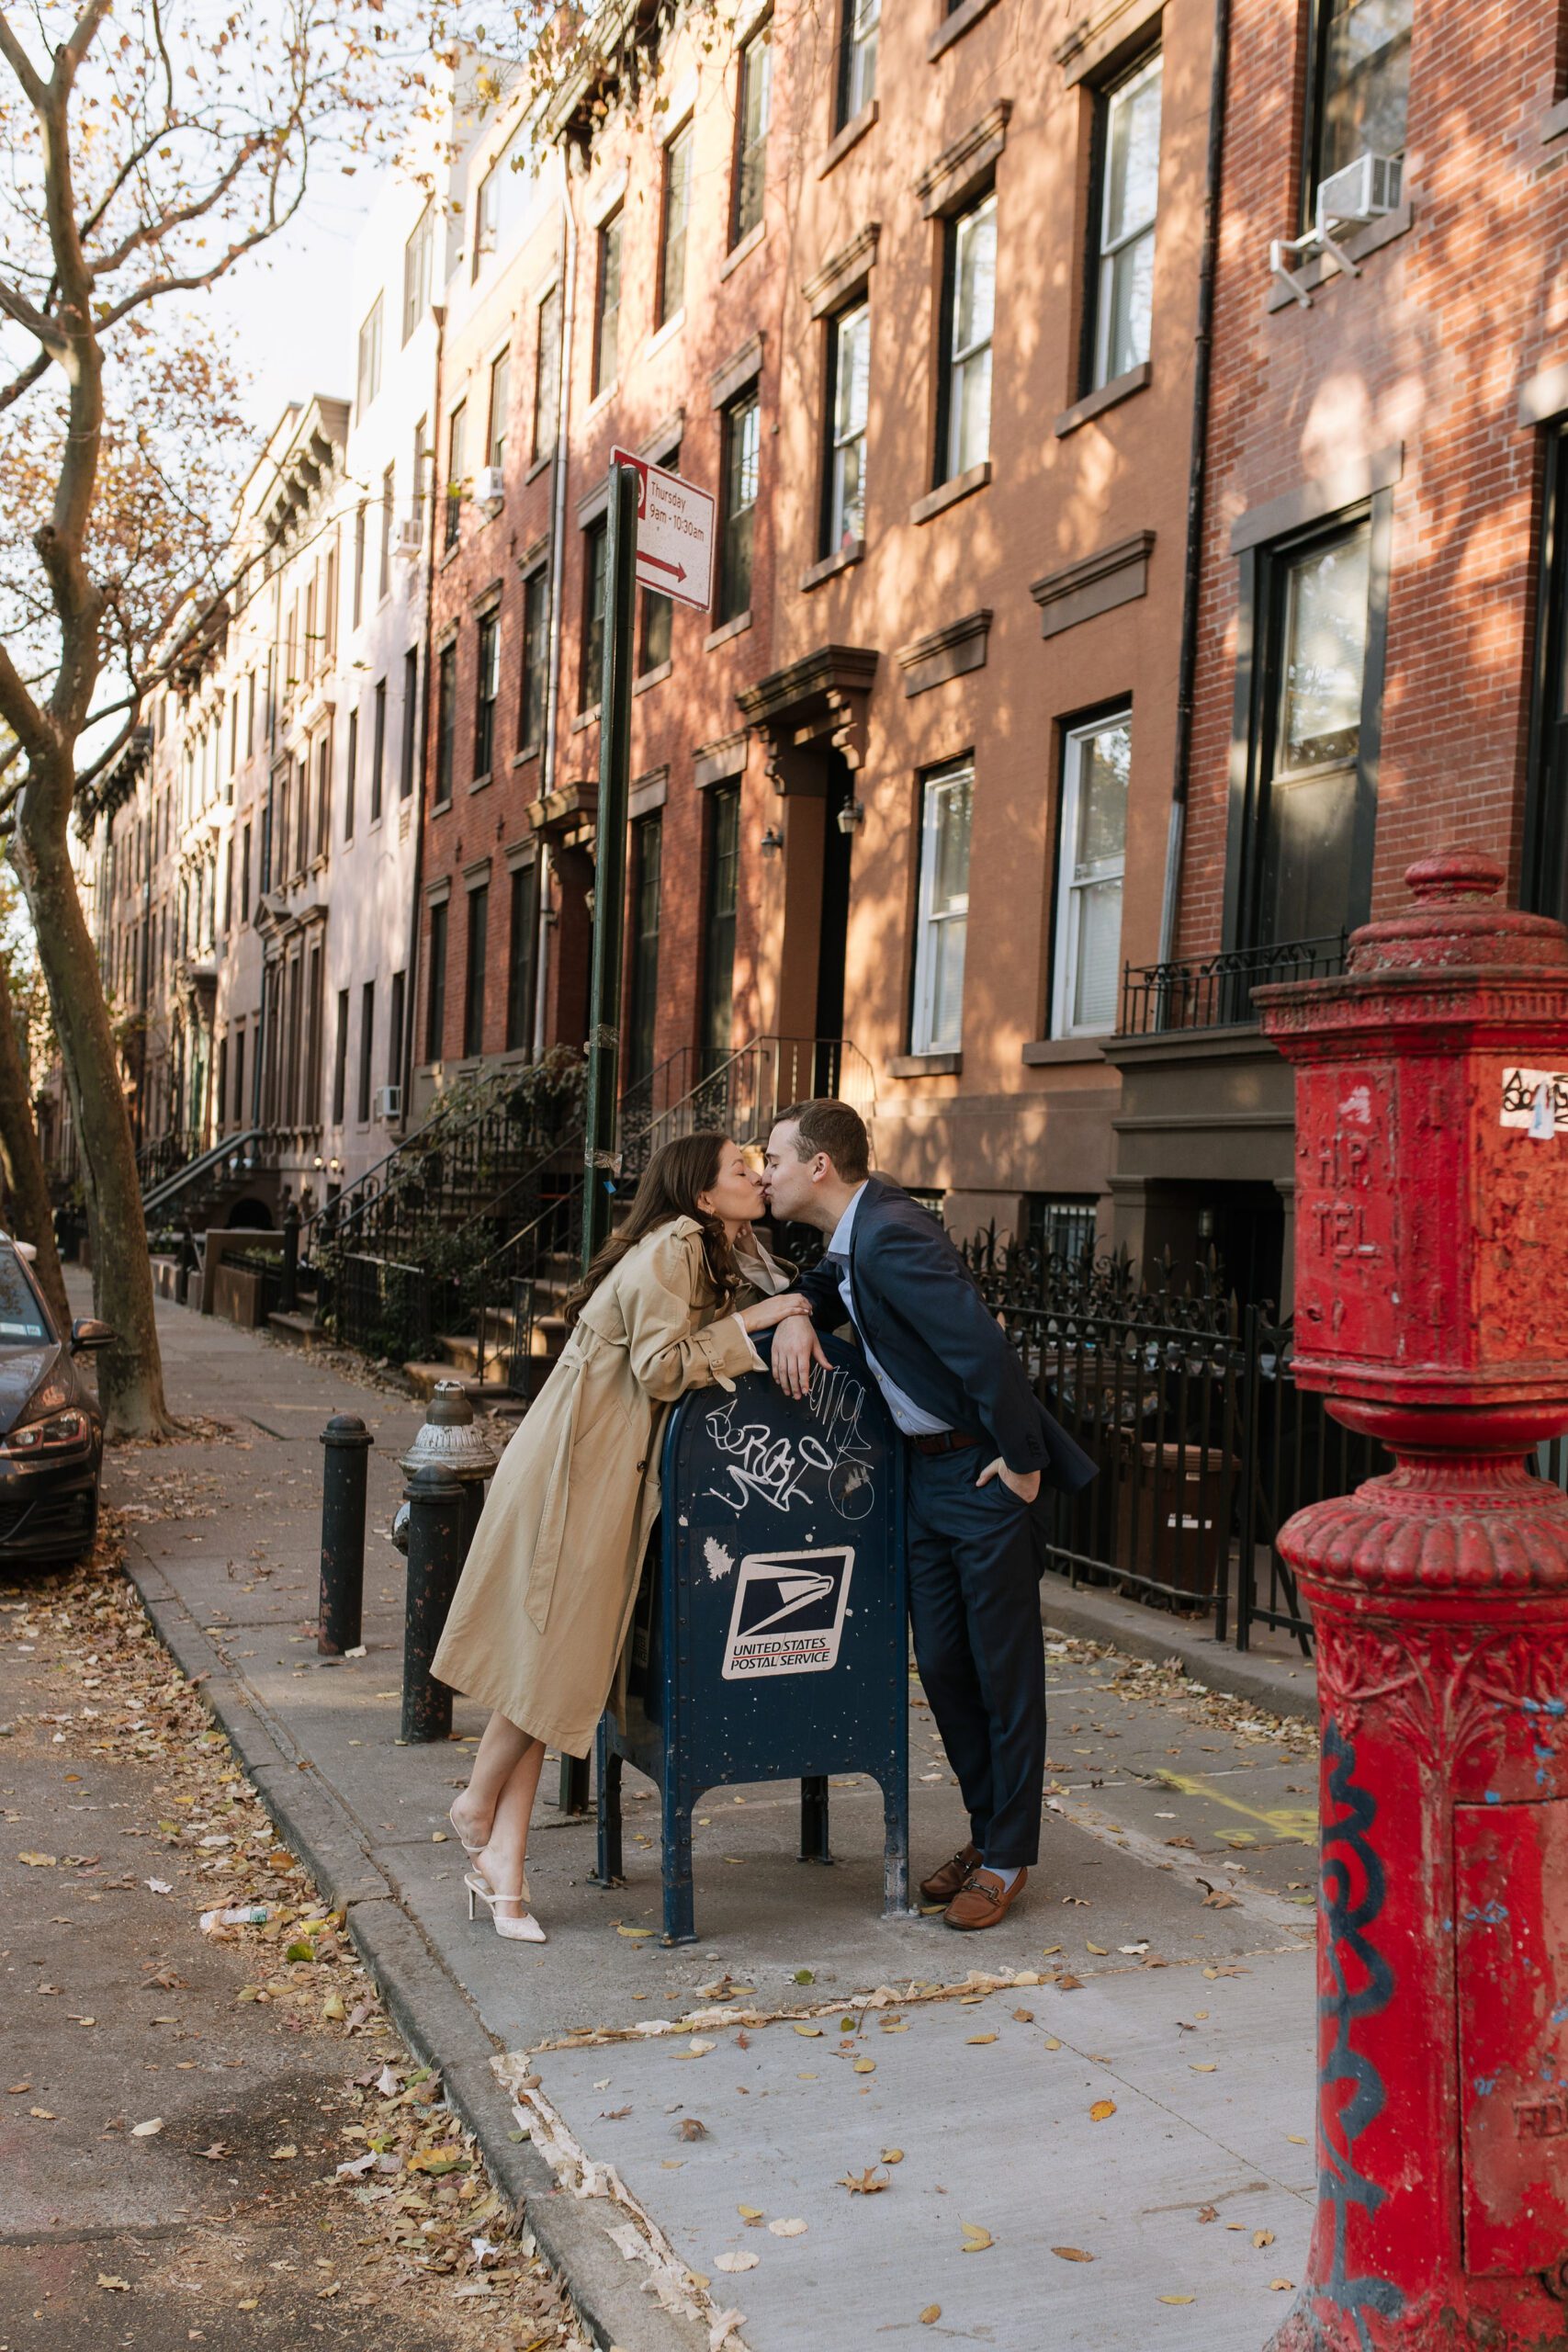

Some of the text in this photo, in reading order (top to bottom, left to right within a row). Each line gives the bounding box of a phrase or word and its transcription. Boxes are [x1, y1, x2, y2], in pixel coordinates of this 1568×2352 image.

[651, 481, 686, 514] Thursday
[650, 503, 667, 524] 9am
[673, 514, 705, 542] 10:30am
[733, 1637, 827, 1657] UNITED STATES
[730, 1651, 830, 1671] POSTAL SERVICE
